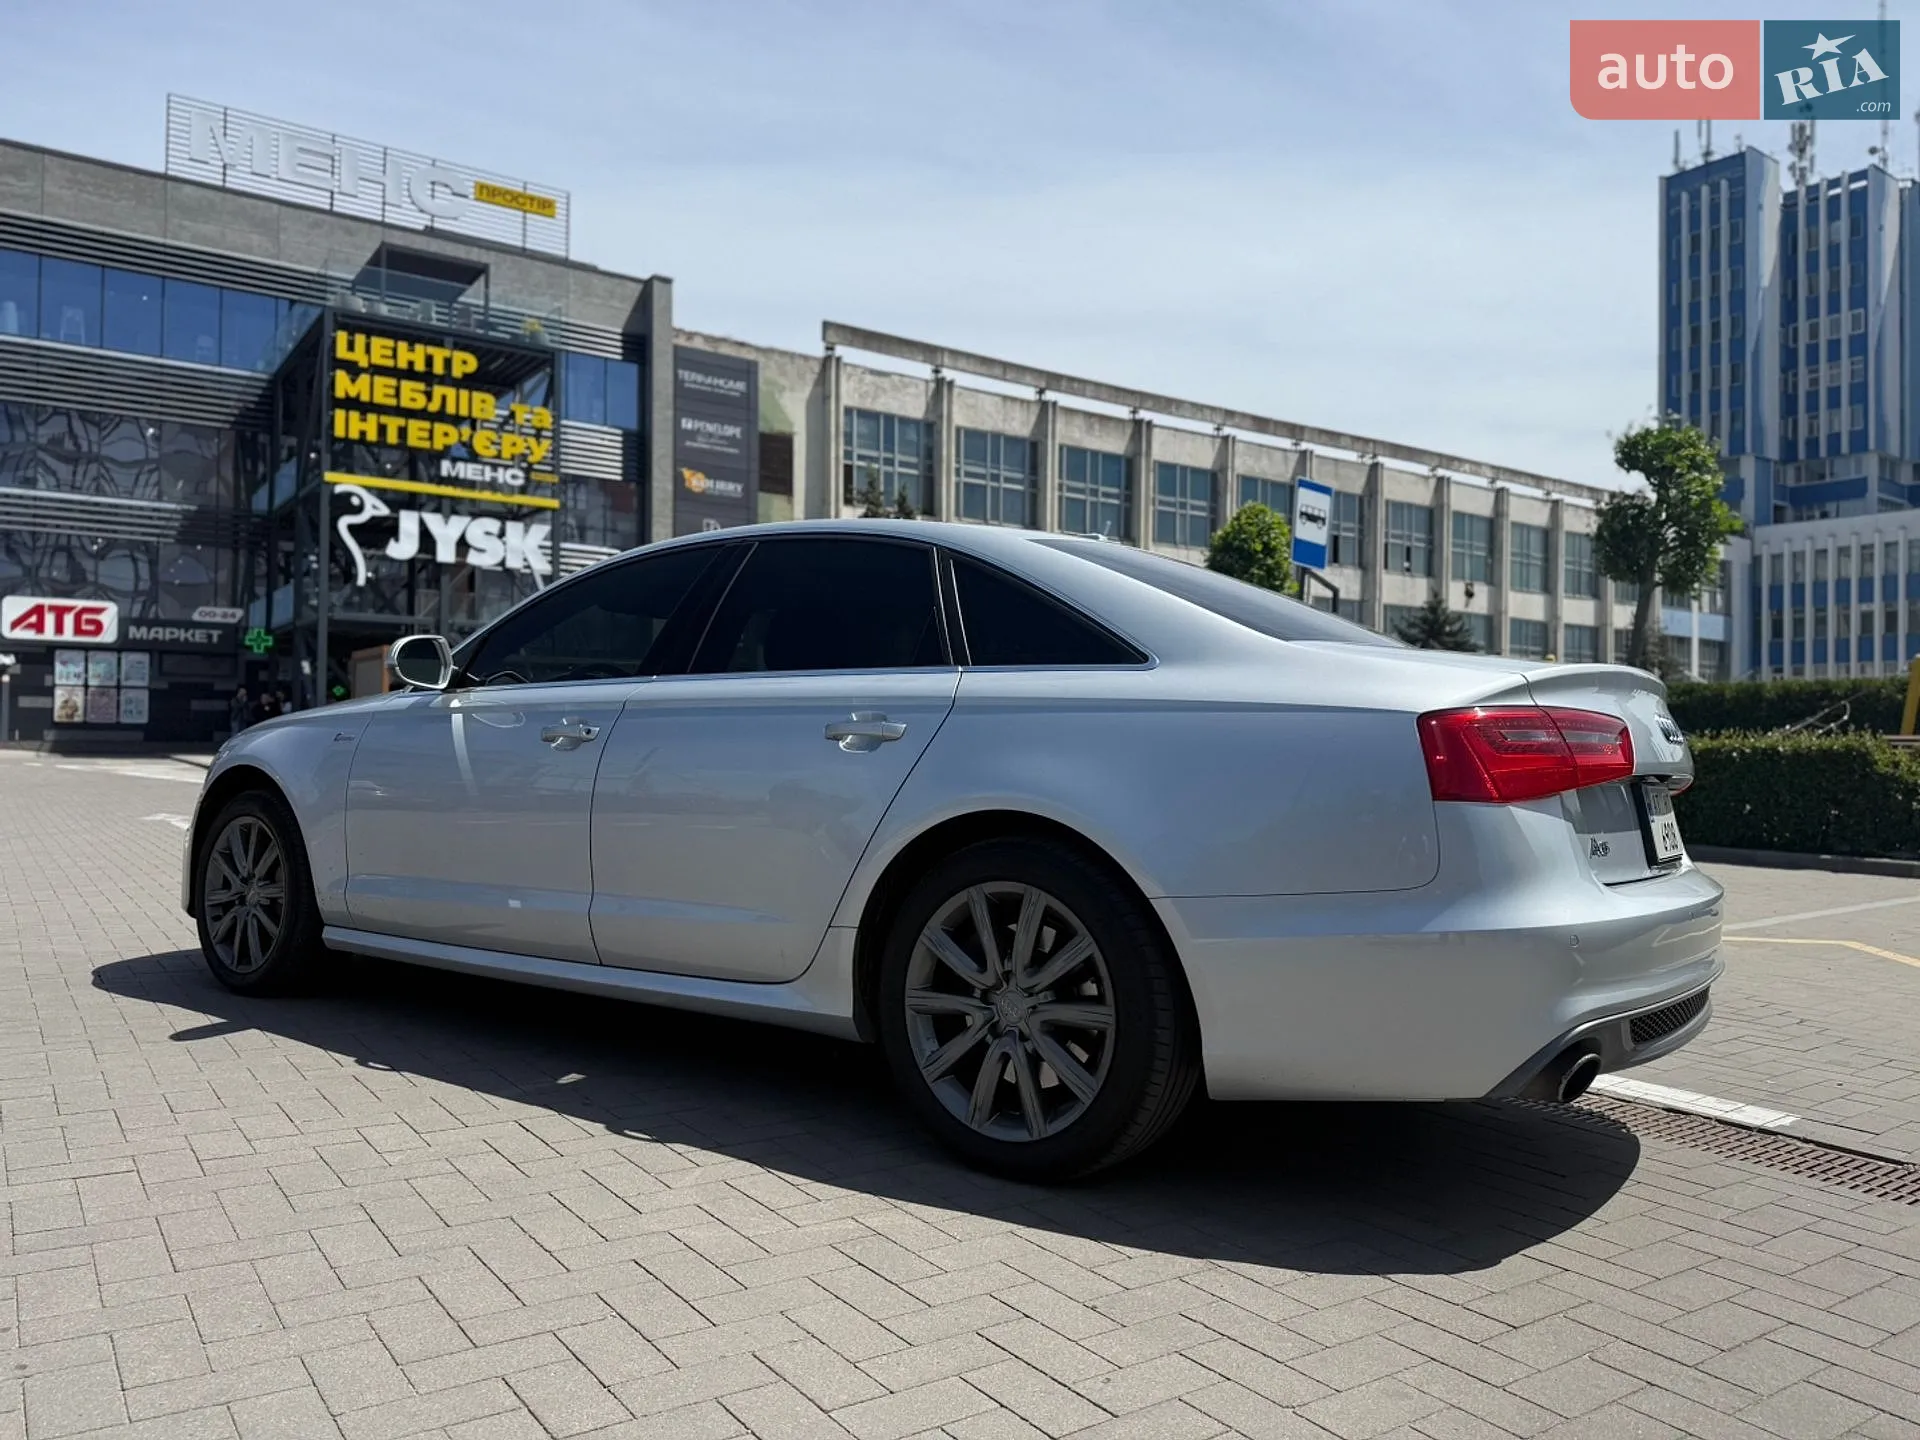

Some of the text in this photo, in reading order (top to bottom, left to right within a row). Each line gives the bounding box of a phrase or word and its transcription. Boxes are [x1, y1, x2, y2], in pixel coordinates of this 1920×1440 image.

[188, 108, 554, 219] МЕНС ПРОСТІР
[335, 329, 479, 379] ЦЕНТР
[334, 369, 553, 429] МЕБЛІВ та
[333, 408, 553, 463] ІНТЕР'ЄРУ
[440, 459, 526, 487] МЕНС
[385, 509, 553, 574] JYSK
[10, 603, 109, 638] АТБ
[128, 625, 223, 644] МАРКЕТ
[1590, 836, 1610, 859] A6
